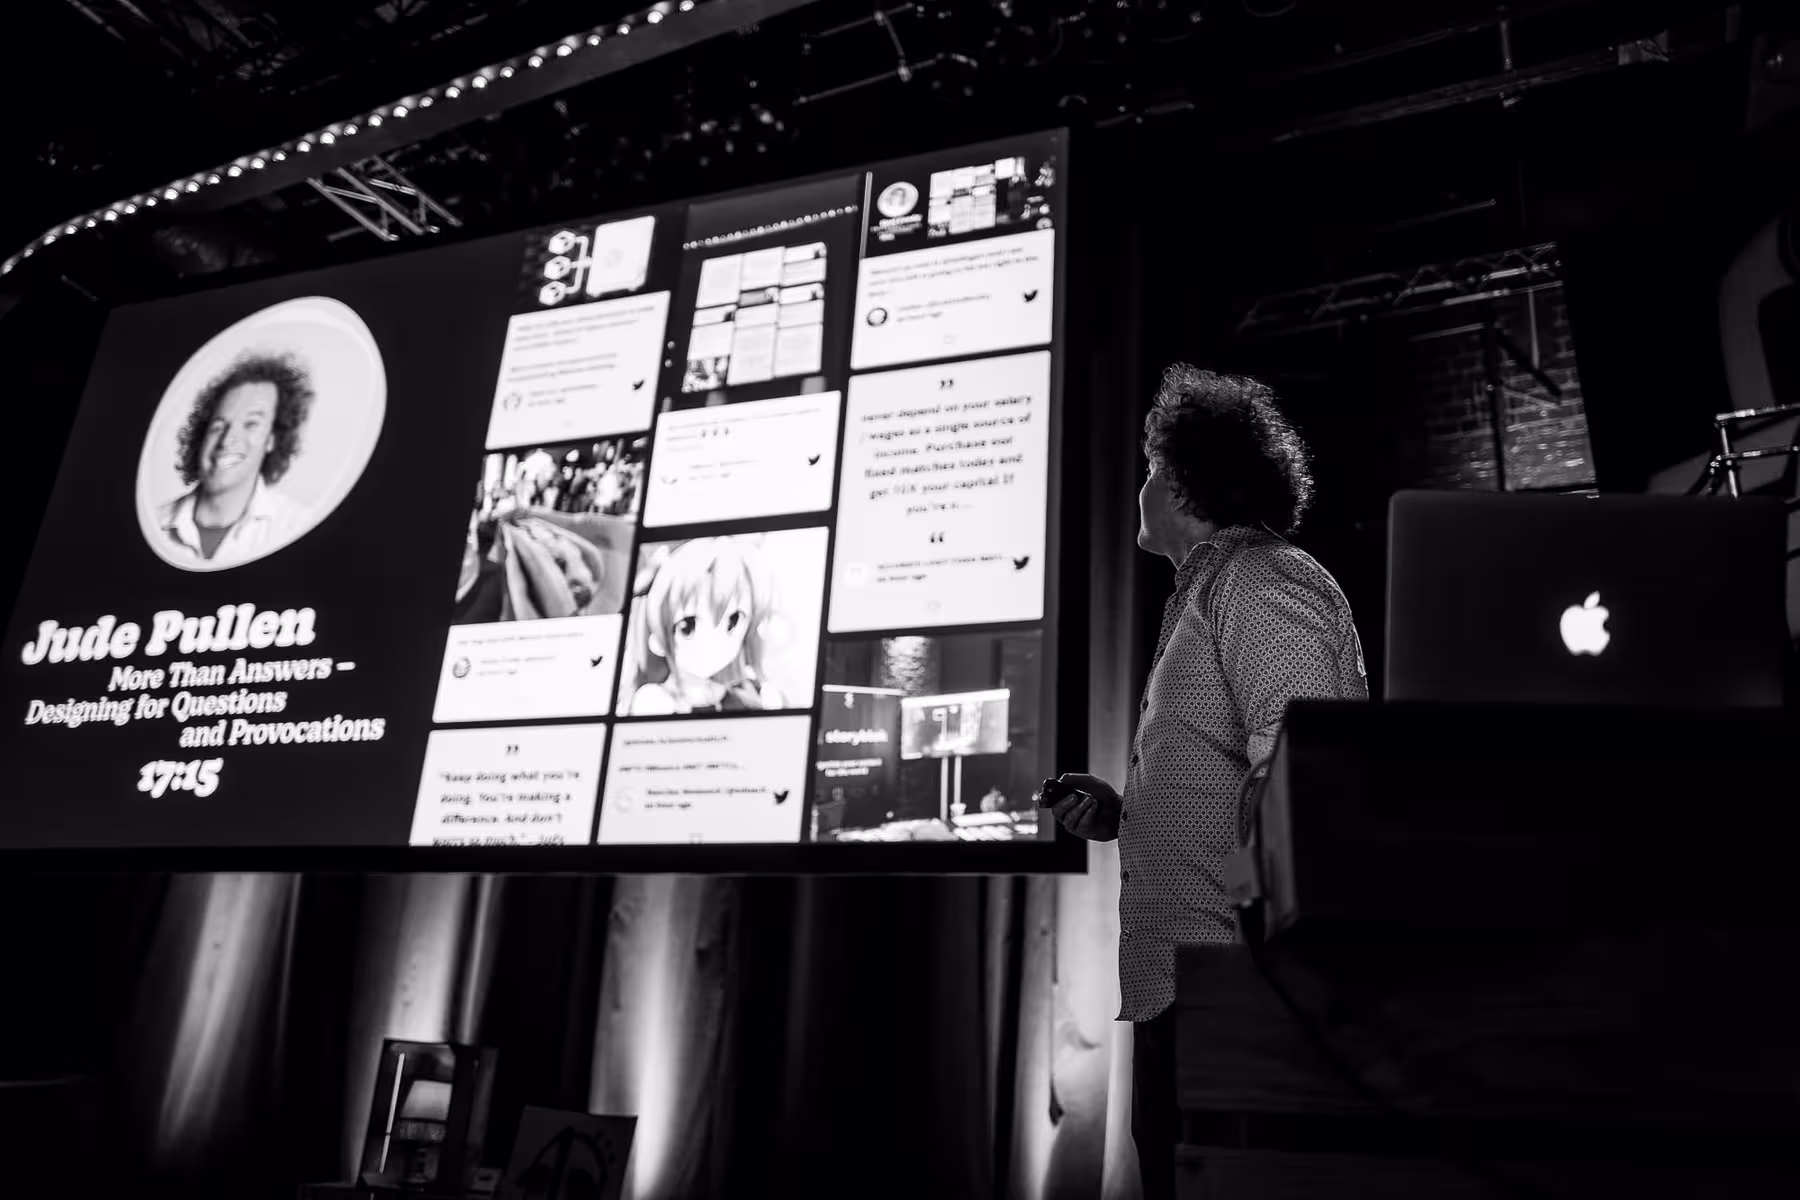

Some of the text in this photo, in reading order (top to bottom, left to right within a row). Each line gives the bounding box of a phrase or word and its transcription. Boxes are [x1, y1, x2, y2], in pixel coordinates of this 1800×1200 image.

[963, 400, 990, 413] your
[21, 602, 317, 665] Jude Pullen
[107, 665, 166, 692] More
[168, 661, 227, 688] Than
[227, 657, 334, 685] Answers
[24, 688, 289, 728] Designing for Questions
[179, 714, 387, 748] and Provocations
[136, 757, 225, 799] 17:15
[475, 771, 507, 784] doing
[518, 791, 561, 804] making
